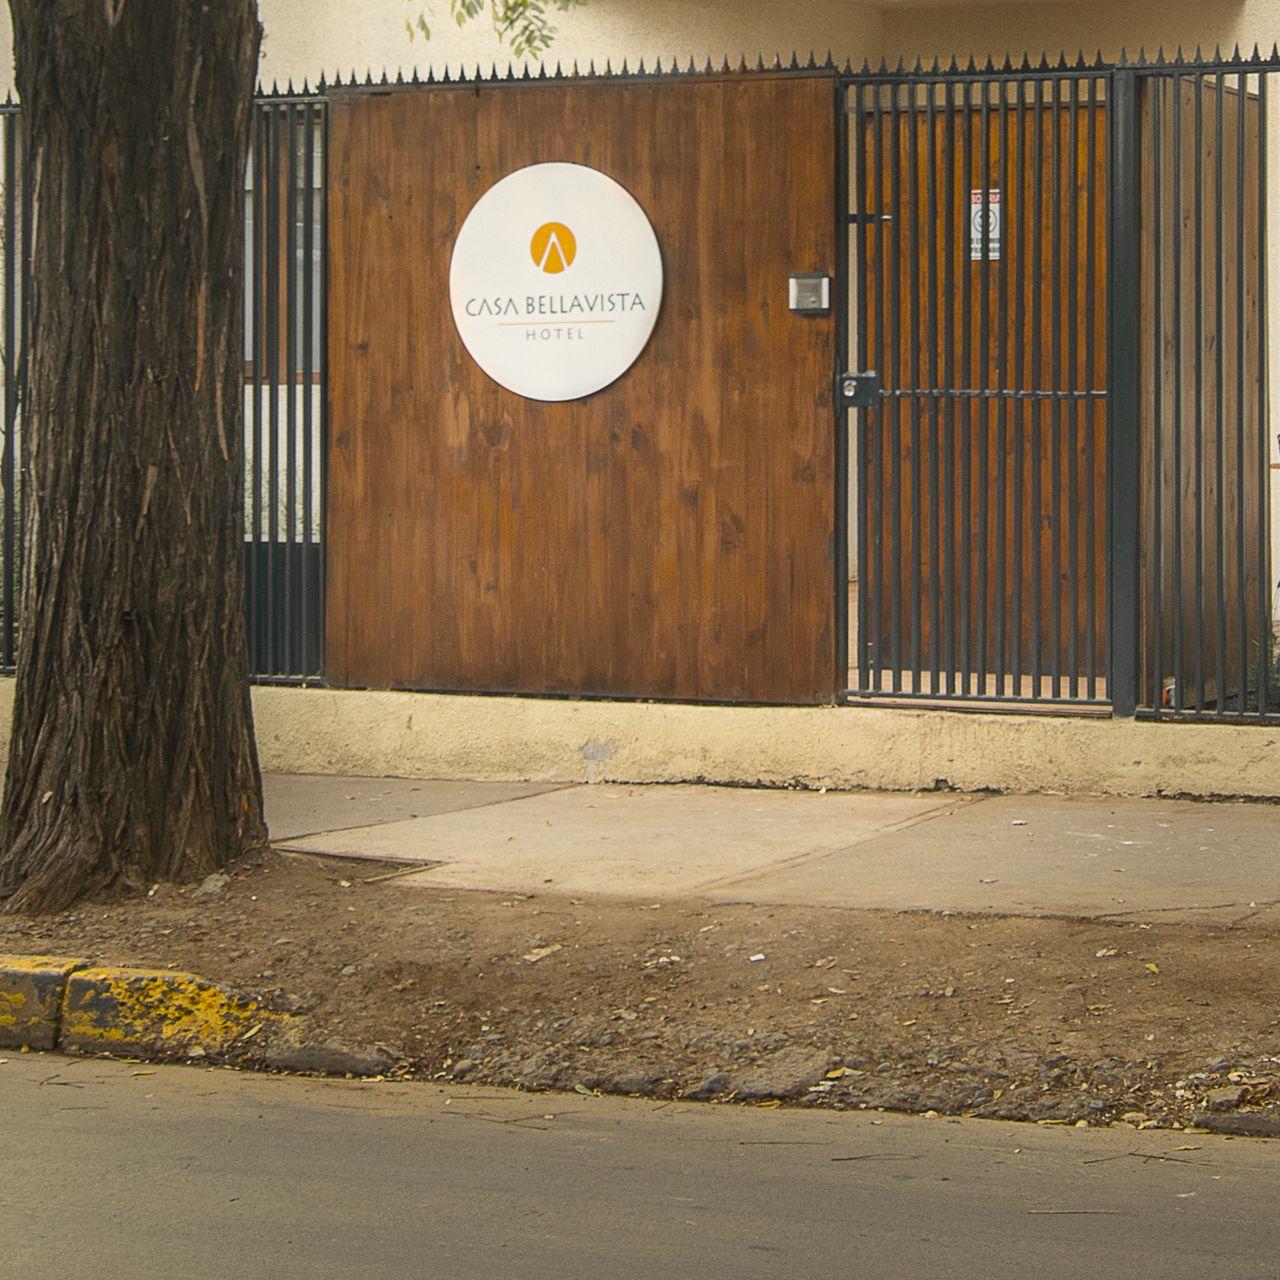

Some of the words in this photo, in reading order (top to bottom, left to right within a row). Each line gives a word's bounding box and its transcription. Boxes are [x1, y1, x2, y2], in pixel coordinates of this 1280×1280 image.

[465, 297, 519, 317] CASA
[525, 292, 646, 315] BELLAVISTA
[525, 327, 584, 341] HOTEL
